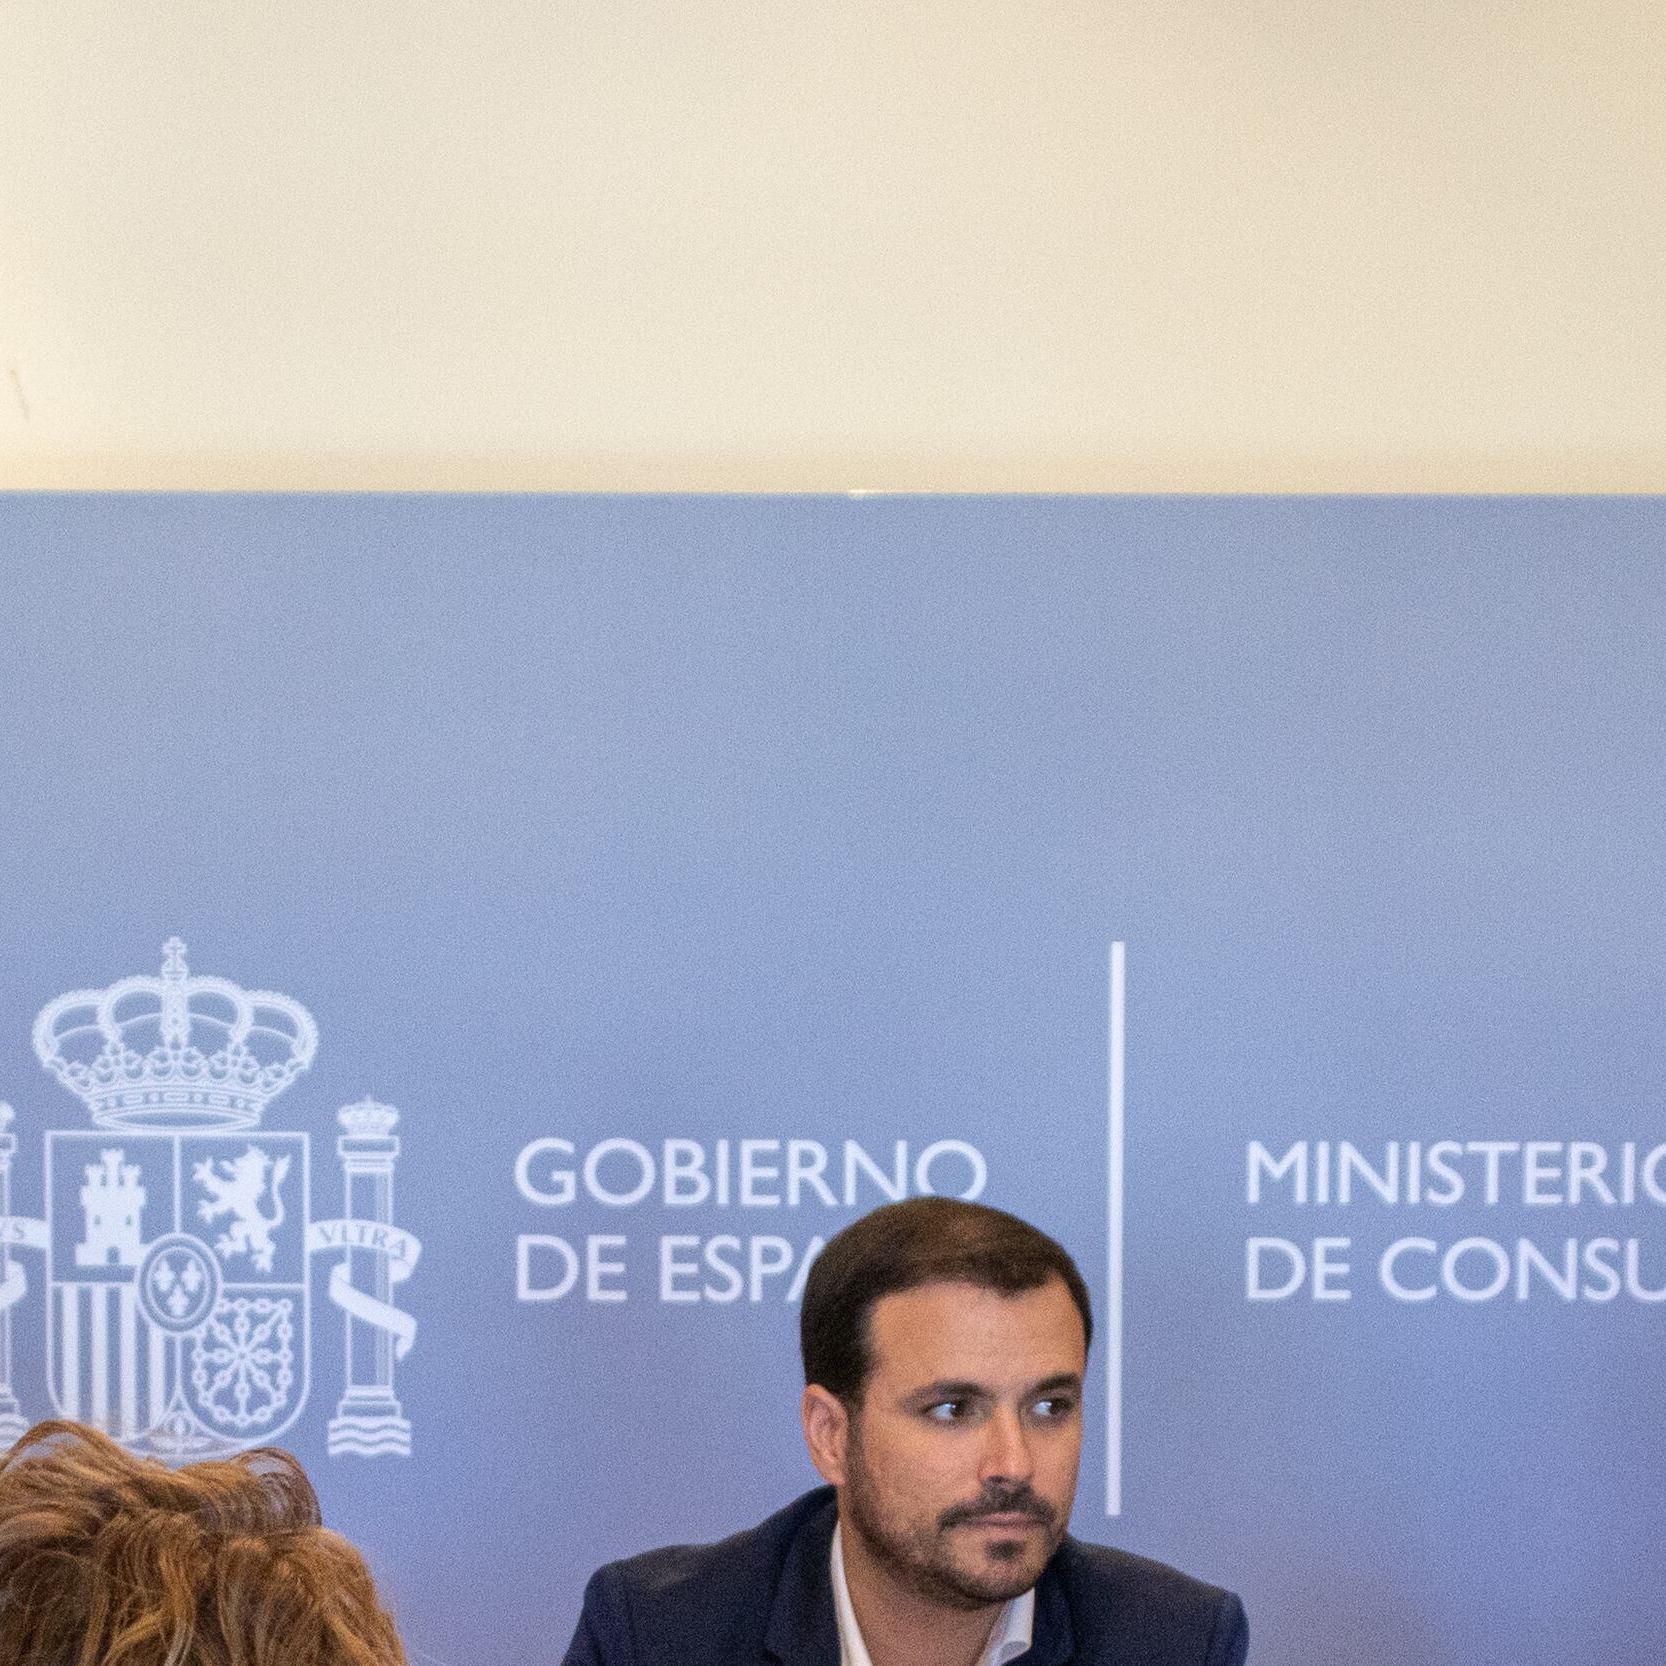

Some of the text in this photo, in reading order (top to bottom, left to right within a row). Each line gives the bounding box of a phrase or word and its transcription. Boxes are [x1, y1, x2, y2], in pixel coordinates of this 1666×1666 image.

[514, 1137, 988, 1206] GOBIERNO
[515, 1234, 628, 1302] DE
[1245, 1237, 1352, 1302] DE
